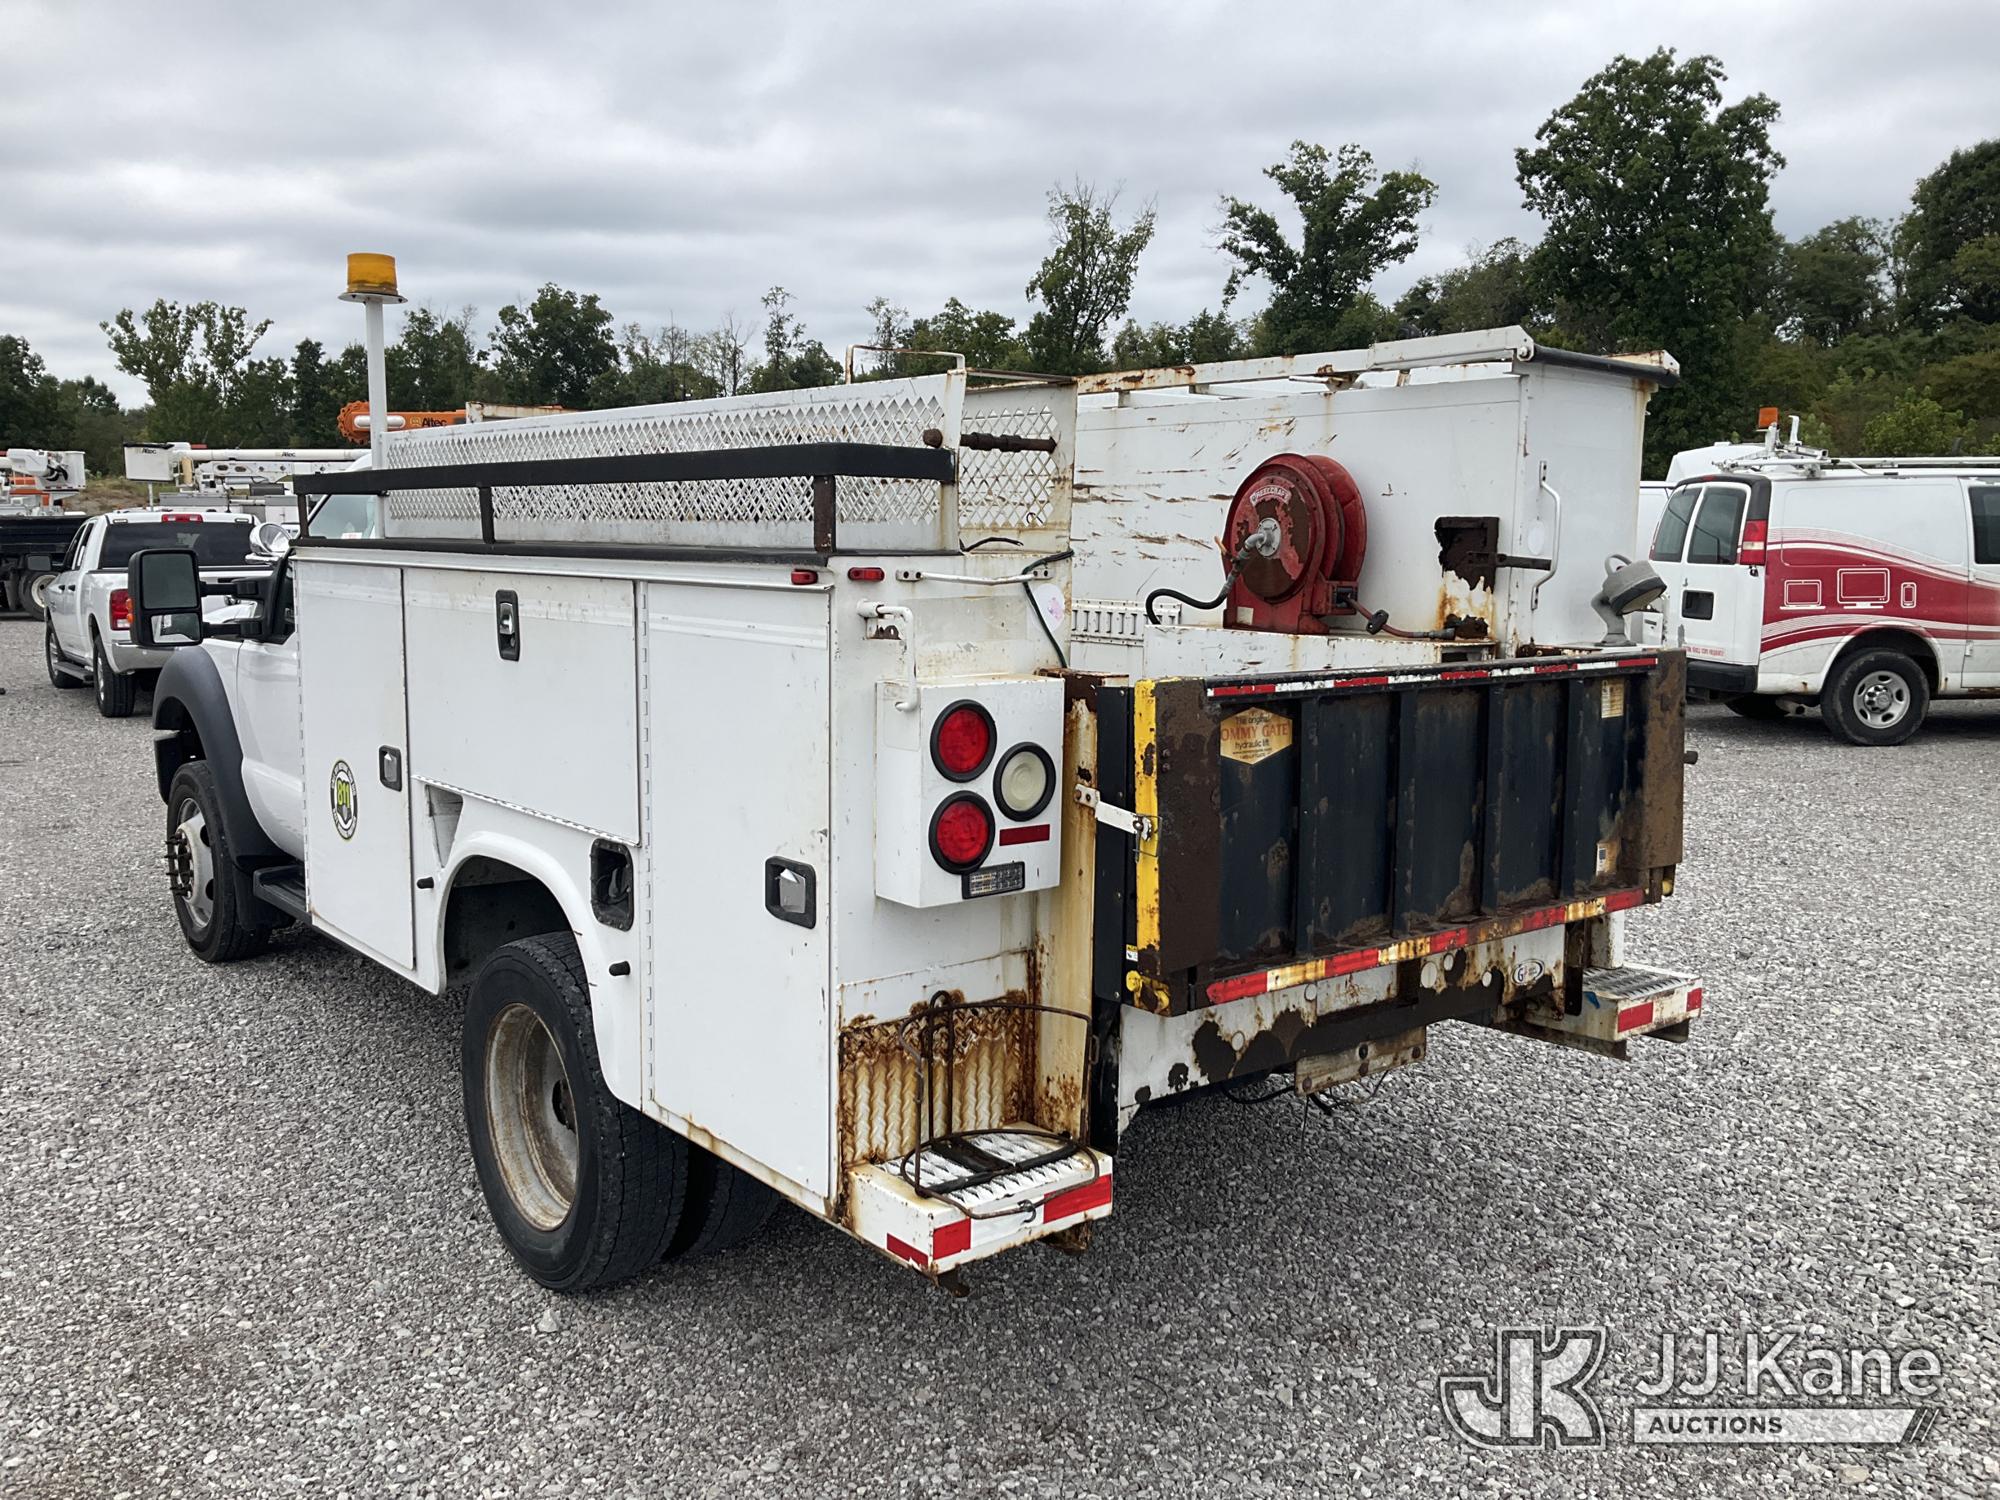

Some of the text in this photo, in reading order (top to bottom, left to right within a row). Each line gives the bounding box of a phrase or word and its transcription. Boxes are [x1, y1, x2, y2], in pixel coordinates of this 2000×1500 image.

[421, 417, 447, 428] Altec
[1221, 722, 1288, 742] OMMY GATE
[336, 777, 351, 810] 811
